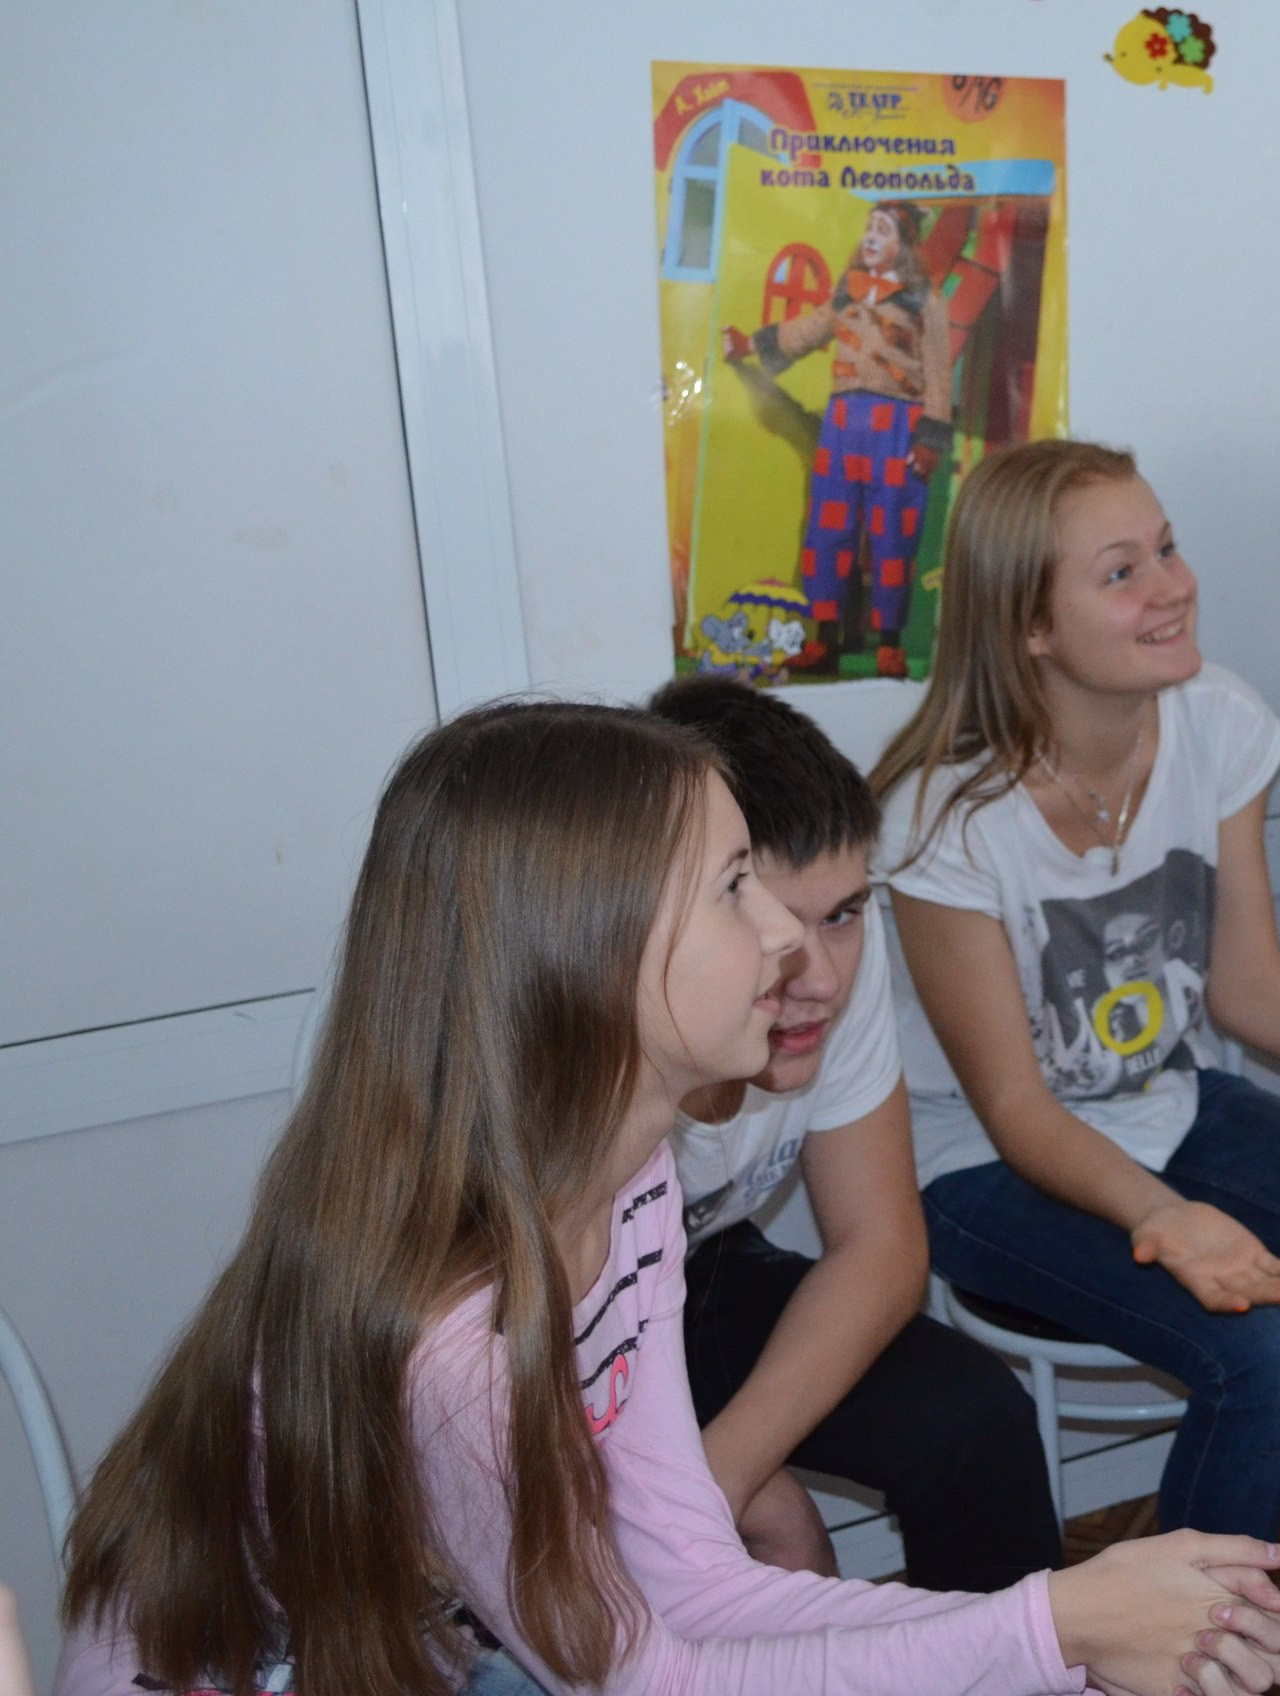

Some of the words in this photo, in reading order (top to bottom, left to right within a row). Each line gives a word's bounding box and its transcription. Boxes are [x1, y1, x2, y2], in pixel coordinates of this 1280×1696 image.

[771, 128, 956, 162] Приключения
[761, 169, 830, 188] кота
[840, 165, 975, 192] Леопольда
